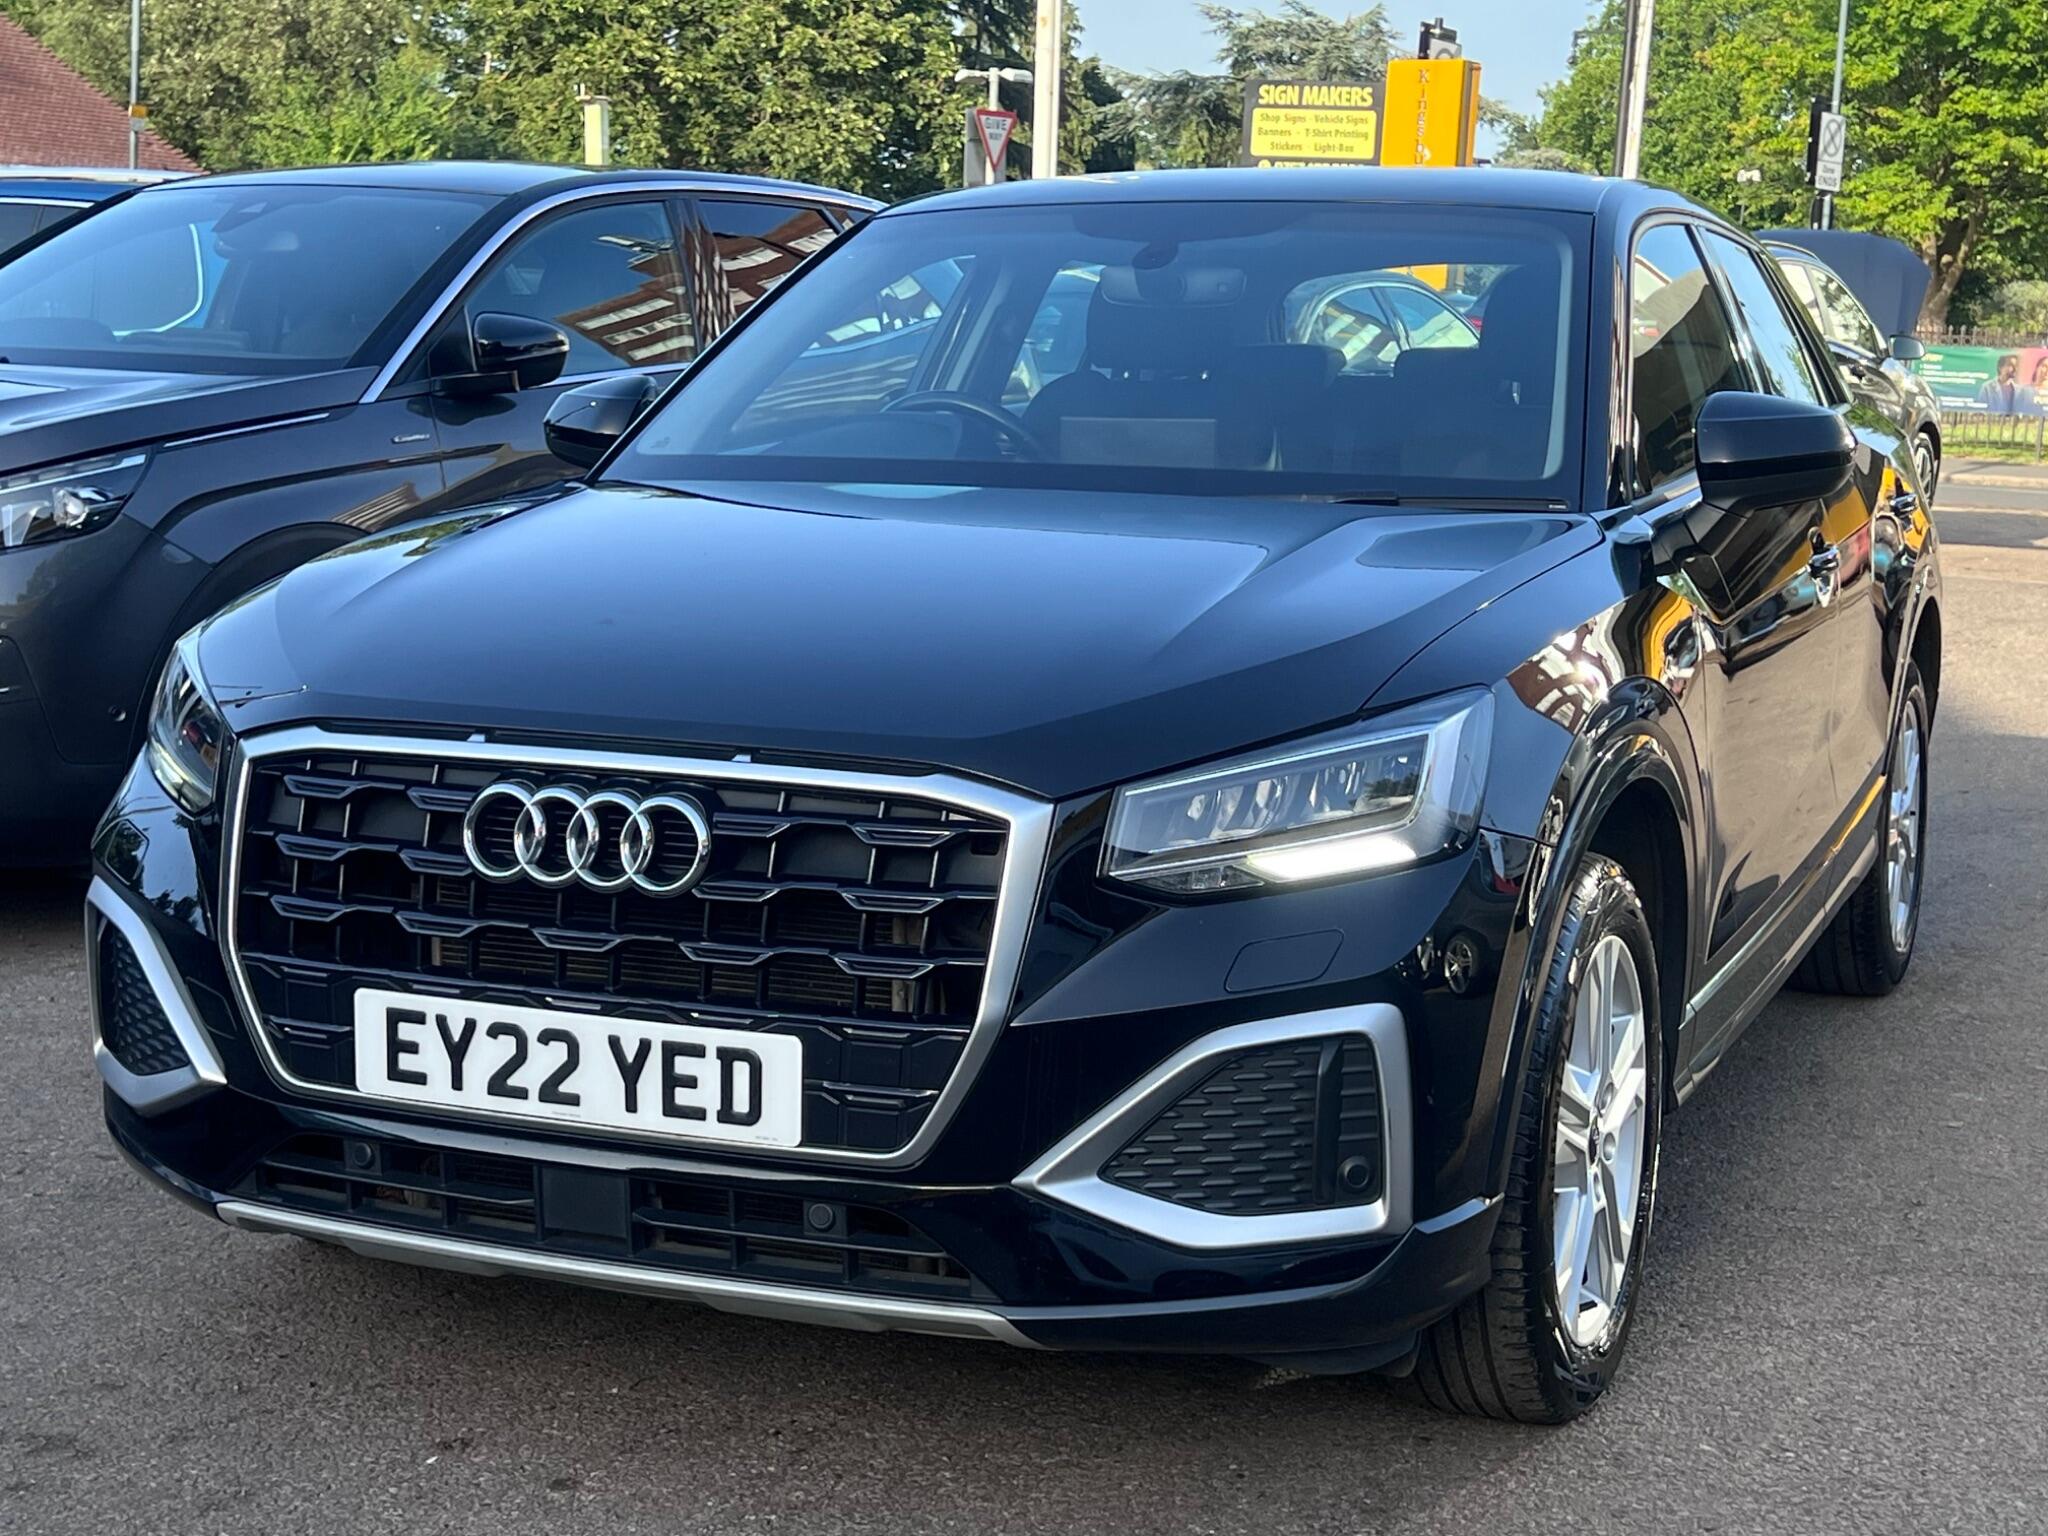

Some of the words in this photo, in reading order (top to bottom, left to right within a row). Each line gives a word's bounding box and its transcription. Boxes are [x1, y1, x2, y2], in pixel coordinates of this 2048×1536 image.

[1258, 84, 1299, 105] SIGN
[1302, 86, 1373, 107] MAKERS
[1260, 113, 1280, 124] Shop
[1285, 113, 1306, 125] Signs
[1315, 114, 1344, 124] Vehicle
[1346, 115, 1368, 127] Signs
[1258, 127, 1292, 136] Banners
[1305, 128, 1332, 138] T-Shirt
[1334, 129, 1369, 140] Printing
[1270, 141, 1303, 151] Stickers
[386, 1006, 580, 1107] EY22
[608, 1033, 763, 1128] YED
